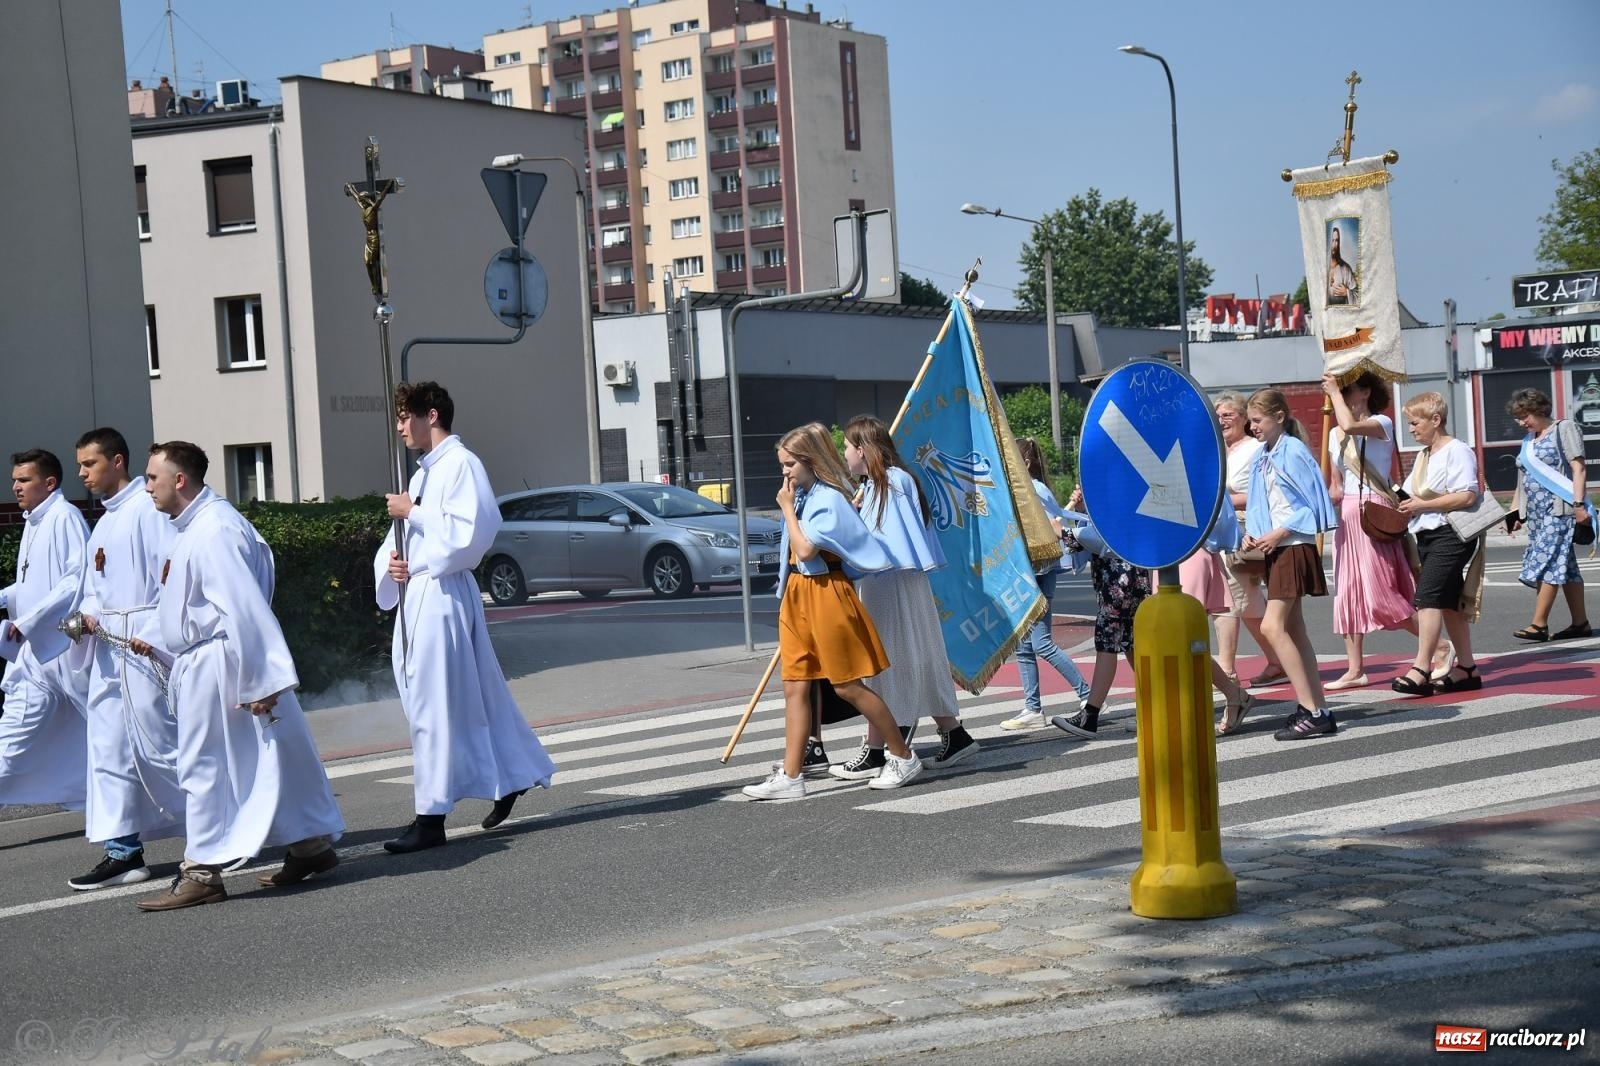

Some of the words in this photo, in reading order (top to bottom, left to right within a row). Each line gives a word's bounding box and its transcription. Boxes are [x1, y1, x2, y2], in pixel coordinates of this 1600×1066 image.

[1500, 329, 1526, 348] MY
[1528, 325, 1587, 346] WIEMY
[1562, 347, 1600, 358] AKCES
